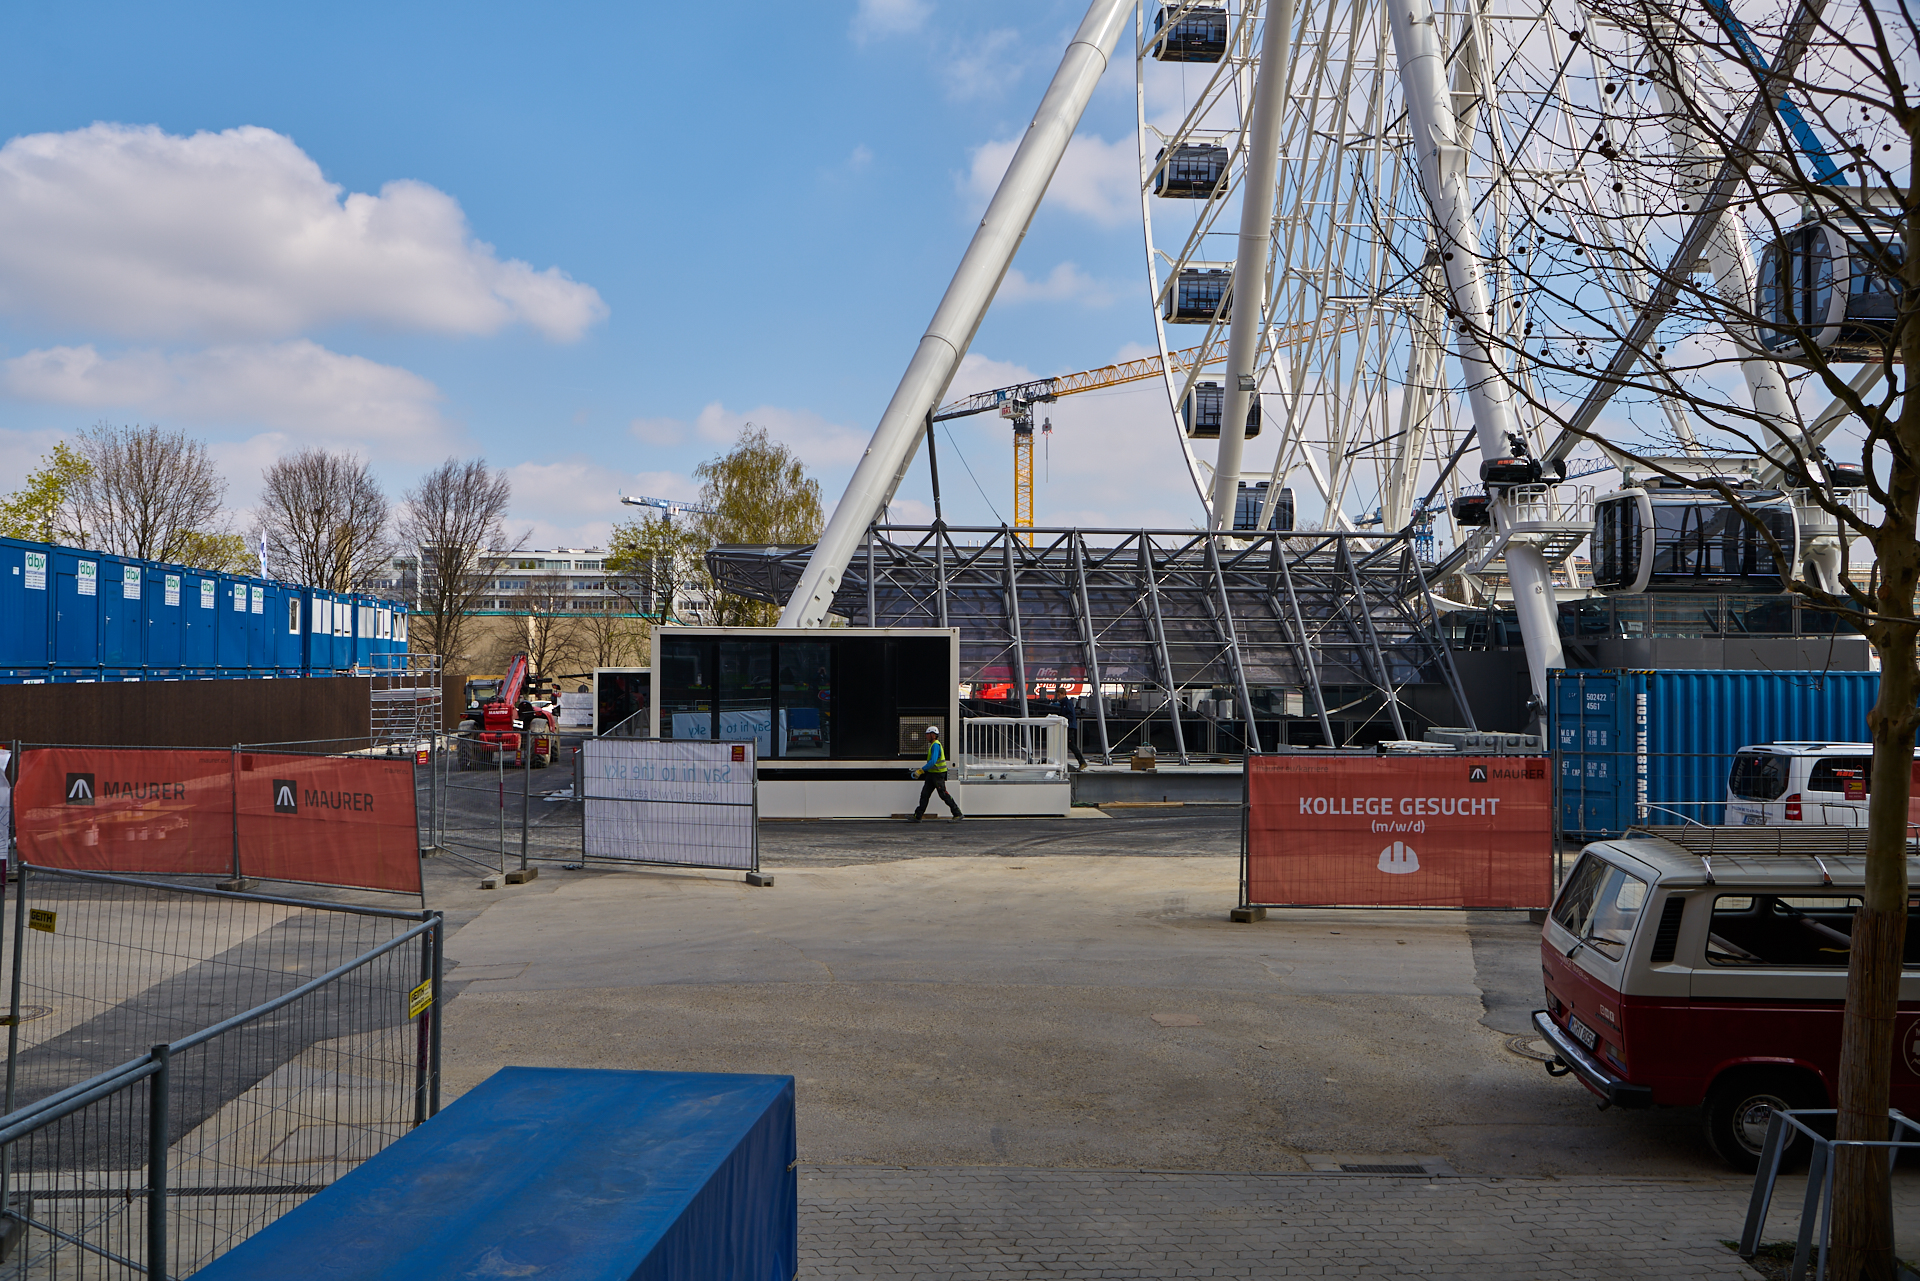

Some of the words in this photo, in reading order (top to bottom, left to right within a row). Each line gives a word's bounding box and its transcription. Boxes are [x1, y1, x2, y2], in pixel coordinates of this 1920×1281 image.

[1586, 693, 1606, 702] 502422
[1493, 770, 1544, 779] MAURER
[104, 782, 185, 800] MAURER
[305, 789, 374, 812] MAURER
[1300, 797, 1393, 815] KOLLEGE
[1400, 798, 1500, 815] GESUCHT
[1371, 820, 1425, 833] (m/w/d)
[31, 911, 52, 923] GEITH
